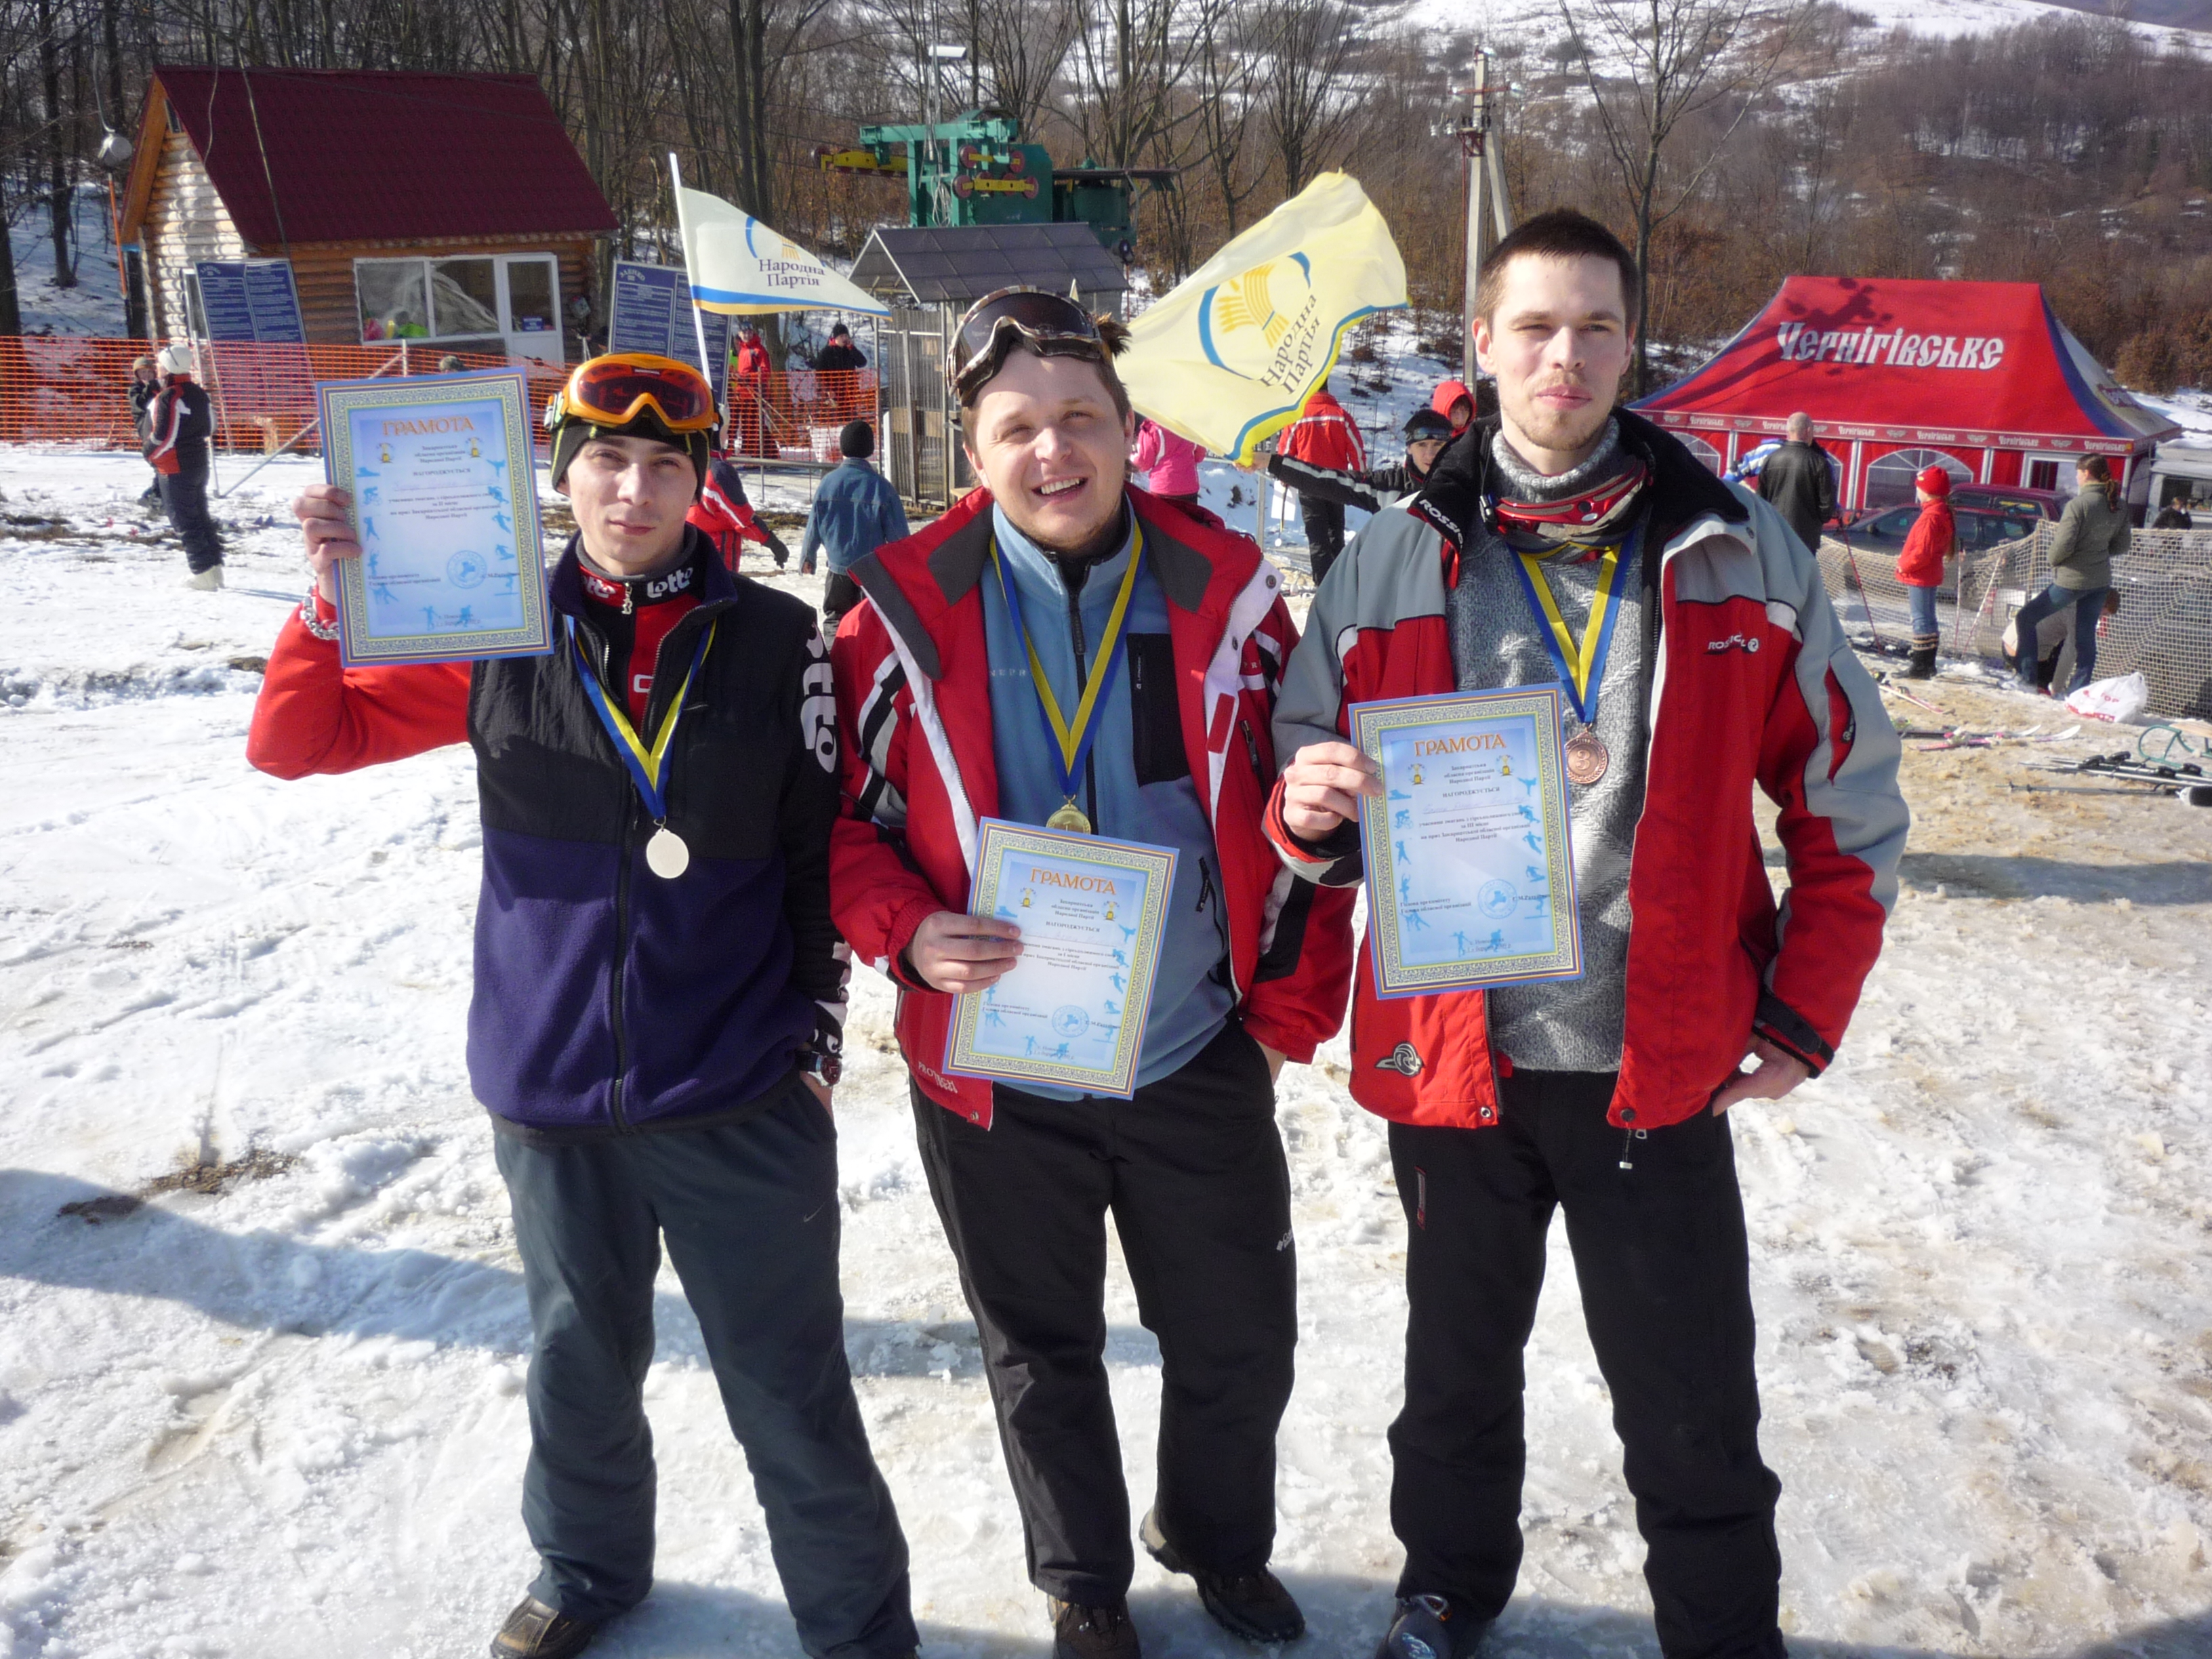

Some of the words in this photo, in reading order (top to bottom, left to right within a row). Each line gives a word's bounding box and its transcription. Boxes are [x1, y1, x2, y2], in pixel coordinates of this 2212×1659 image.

[759, 258, 825, 276] Народна
[767, 273, 820, 289] Партія
[1257, 294, 1317, 387] Народна
[1776, 321, 2005, 370] Чернігівське
[1280, 316, 1321, 394] Партія
[382, 416, 475, 436] ГРАМОТА
[647, 567, 693, 598] Lotto
[1414, 733, 1507, 757] ГРАМОТА
[1576, 750, 1591, 771] 3
[1030, 867, 1117, 896] ГРАМОТА
